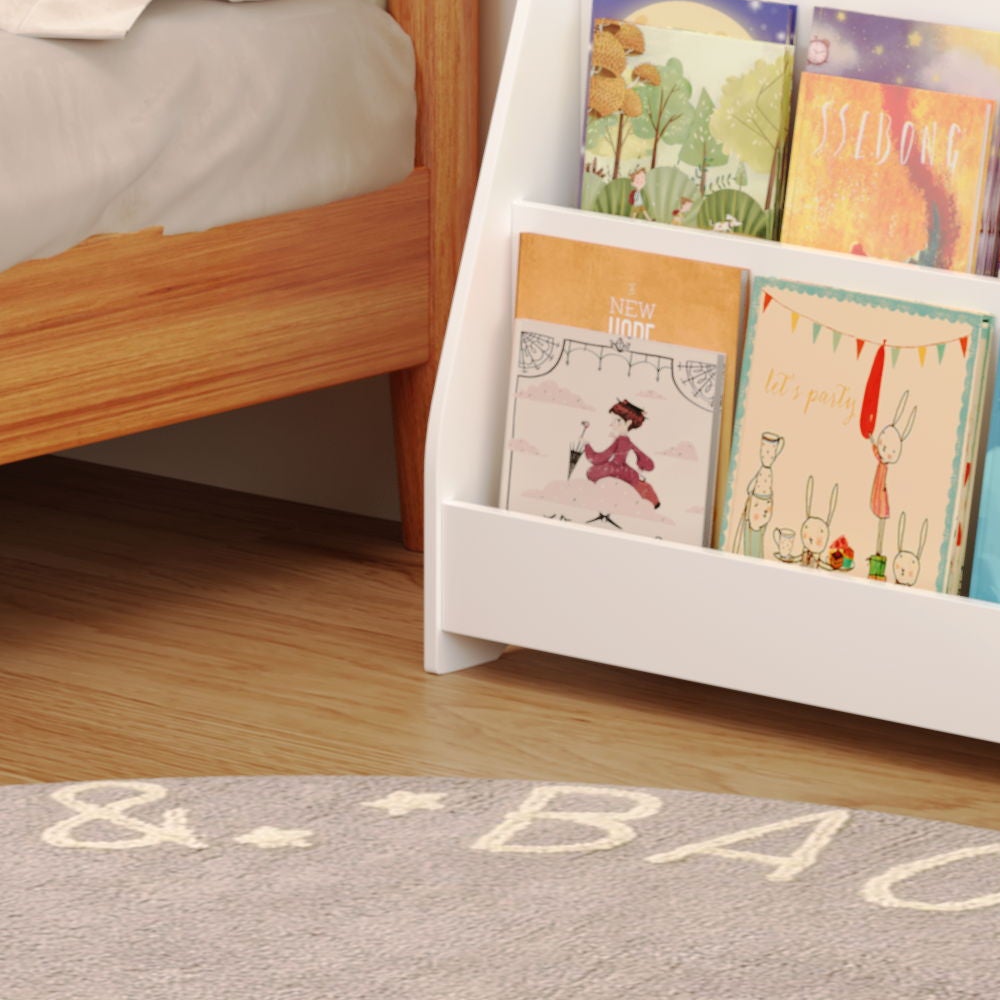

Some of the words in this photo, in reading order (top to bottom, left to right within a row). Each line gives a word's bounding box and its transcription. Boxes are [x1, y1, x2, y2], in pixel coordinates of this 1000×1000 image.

[811, 100, 964, 170] SSEBONG
[608, 296, 657, 320] NEW
[803, 383, 857, 427] party
[40, 779, 209, 850] &
